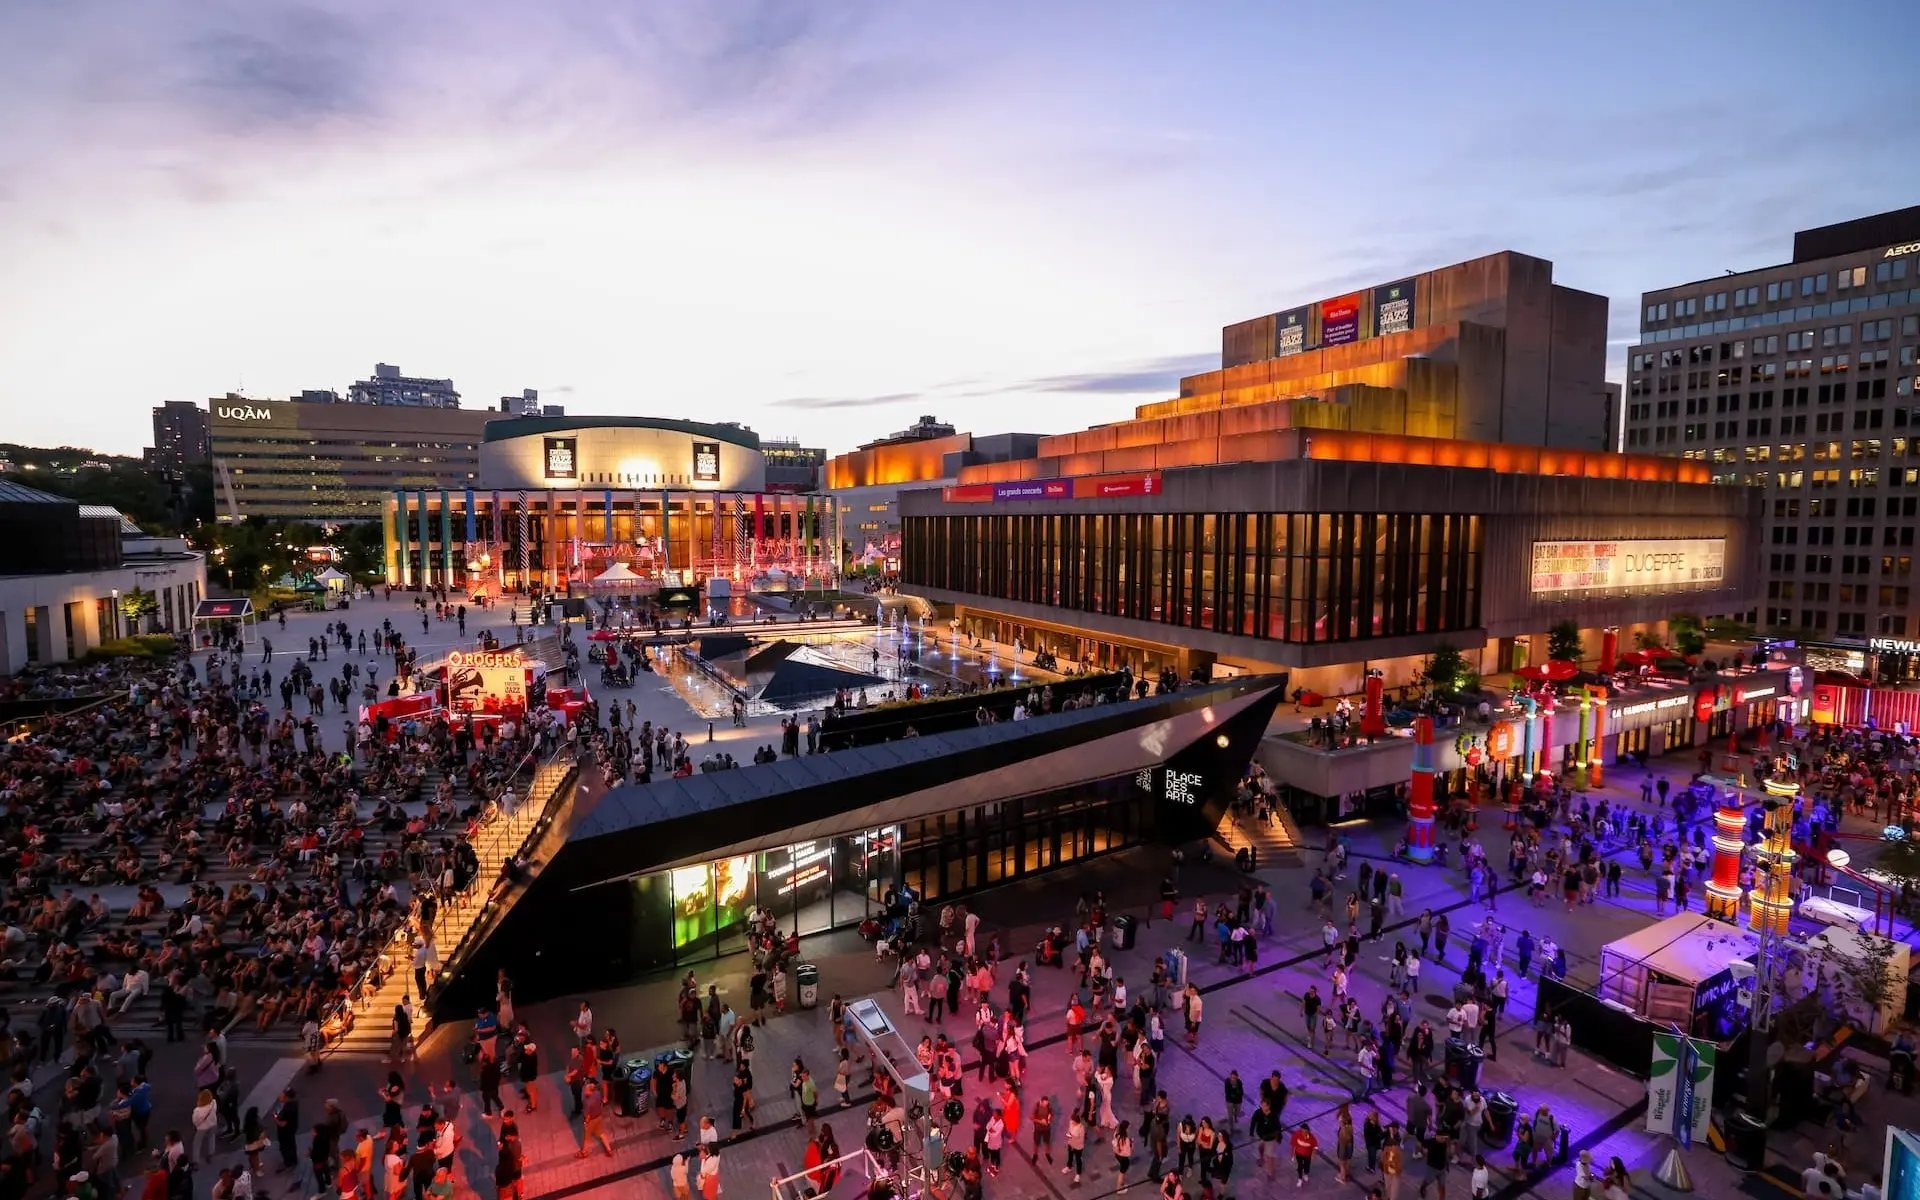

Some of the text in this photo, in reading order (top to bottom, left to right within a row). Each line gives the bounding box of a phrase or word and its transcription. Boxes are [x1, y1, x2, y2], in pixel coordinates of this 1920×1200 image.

[1884, 243, 1920, 258] AECO
[1383, 308, 1409, 324] JAZZ
[1282, 334, 1303, 347] JAZZ
[218, 405, 271, 421] UQÀM
[1006, 488, 1021, 498] grands
[1022, 487, 1042, 496] concerts
[1626, 553, 1686, 572] DUCEPPE
[1870, 638, 1920, 651] NEWL
[465, 653, 521, 667] ROGERS
[1612, 708, 1622, 718] LA
[1166, 769, 1202, 786] PLACE
[1166, 779, 1188, 793] DES
[1166, 789, 1195, 805] ARTS
[1654, 1088, 1666, 1121] Brigade
